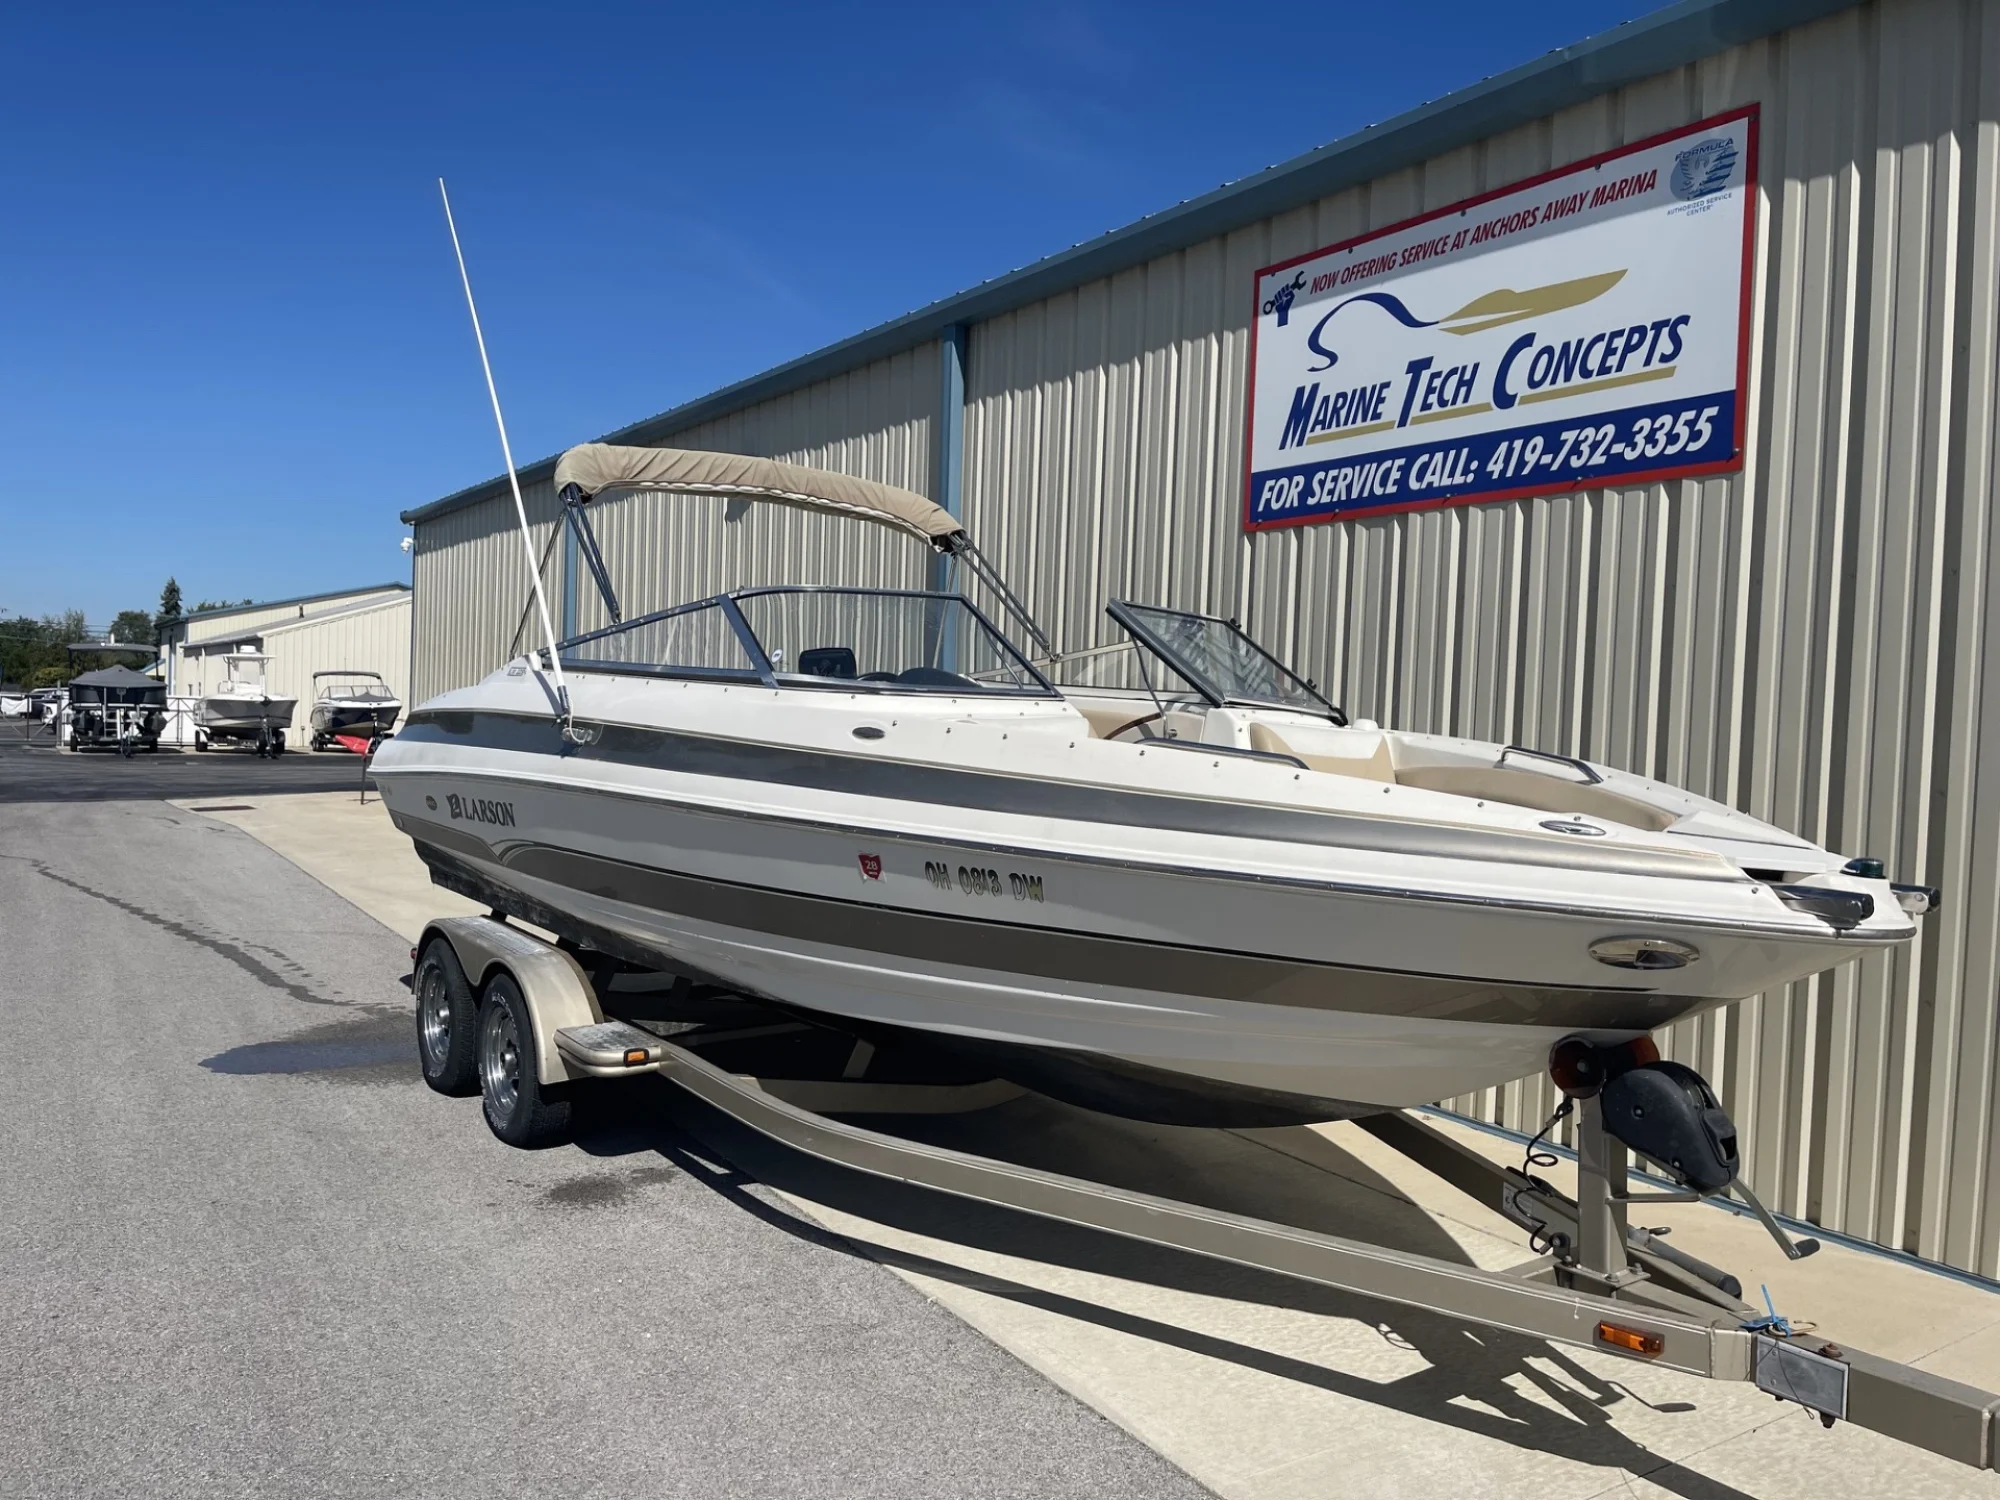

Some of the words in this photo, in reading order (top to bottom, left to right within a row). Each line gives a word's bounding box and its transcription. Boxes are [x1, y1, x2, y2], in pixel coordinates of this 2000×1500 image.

[1675, 137, 1734, 162] FORMULA
[1667, 200, 1705, 216] AUTHORIZED
[1706, 192, 1733, 205] SERVICE
[1310, 270, 1339, 295] NOW
[1340, 252, 1398, 284] OFFERING
[1399, 235, 1450, 268] SERVICE
[1450, 228, 1470, 252] AT
[1469, 206, 1540, 246] ANCHORS
[1541, 190, 1590, 224] AWAY
[1589, 169, 1658, 208] MARINA
[1278, 380, 1392, 451] MARINE
[1396, 355, 1480, 429] TECH
[1492, 314, 1691, 410] CONCEPTS
[1257, 473, 1304, 513] FOR
[1306, 456, 1407, 507] SERVICE
[1408, 446, 1479, 493] CALL:
[1485, 406, 1720, 481] 419-732-3355
[462, 796, 516, 828] LARSON
[924, 861, 953, 891] OH
